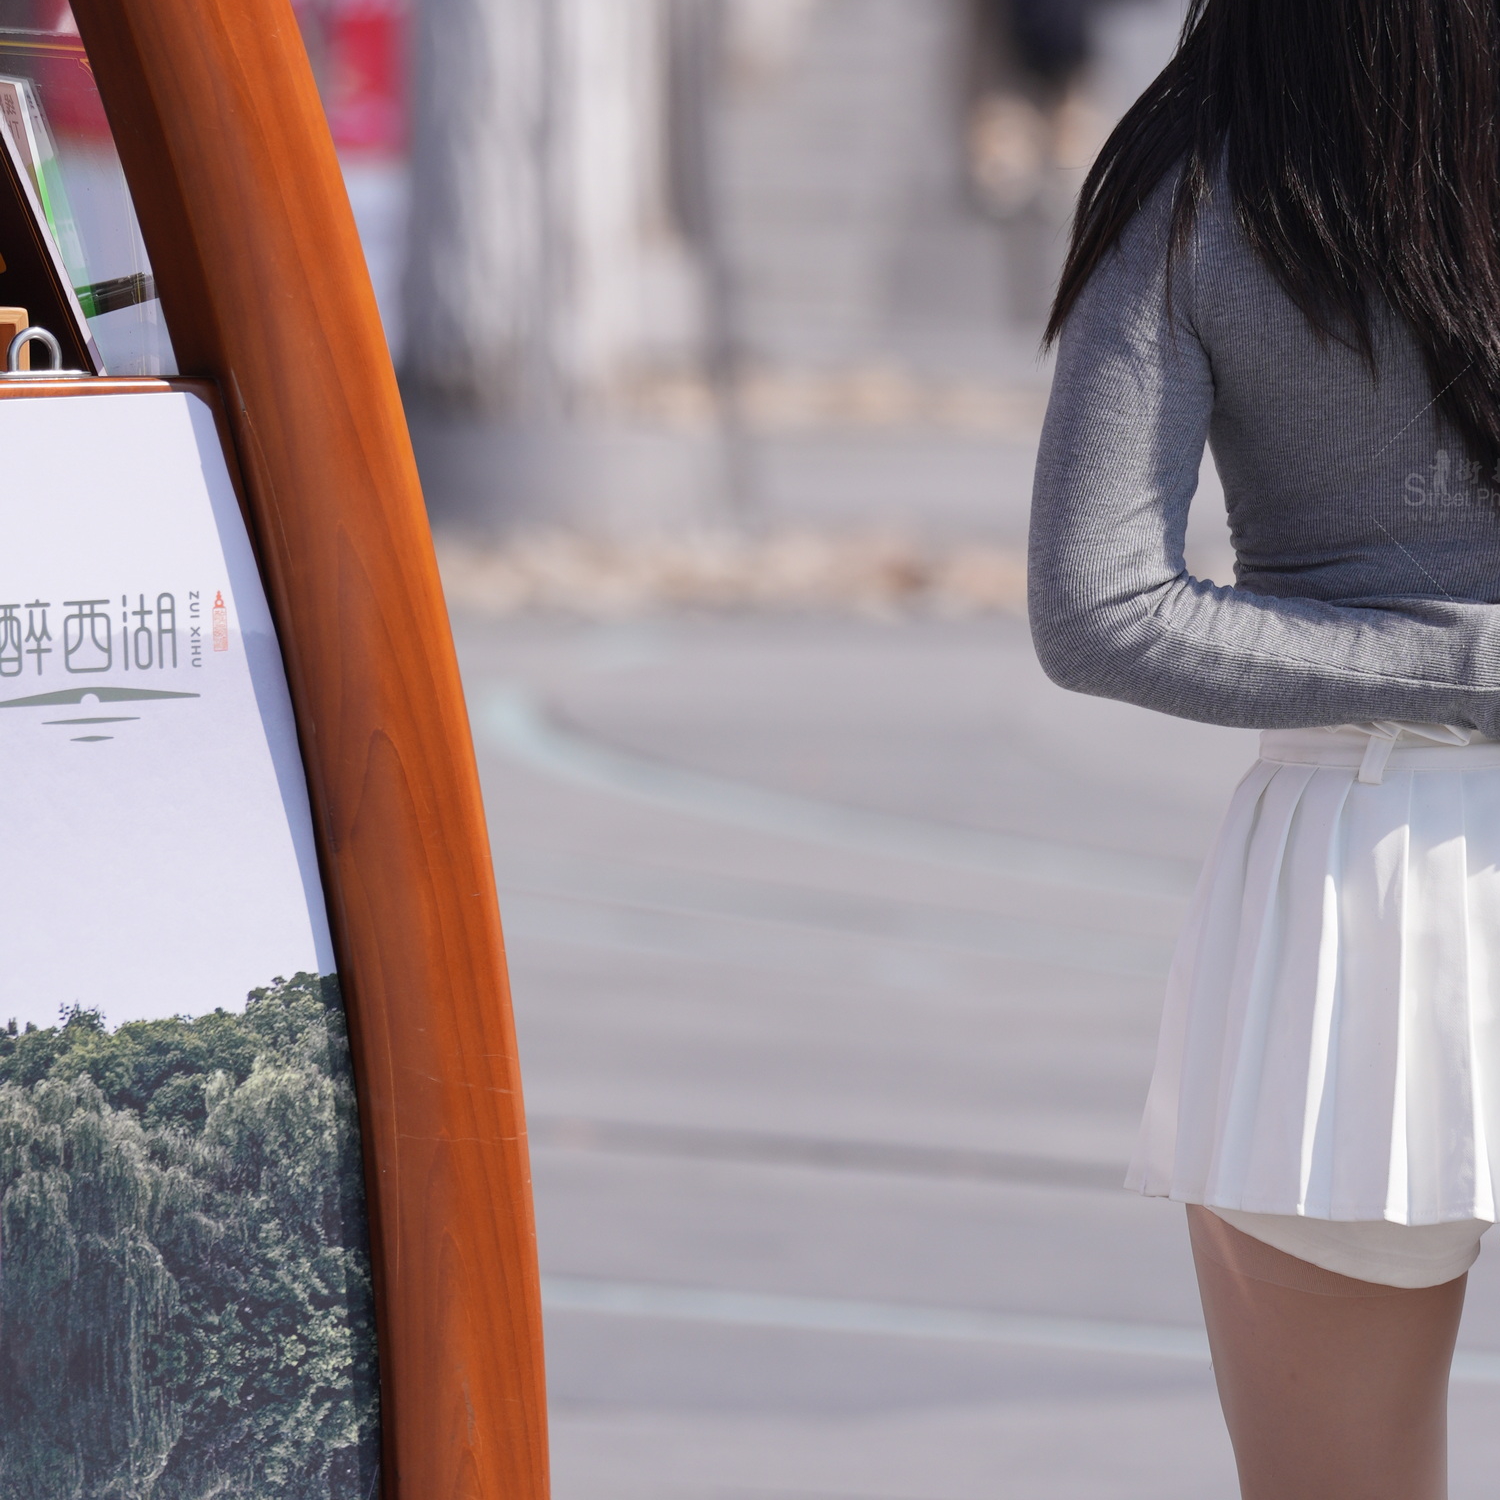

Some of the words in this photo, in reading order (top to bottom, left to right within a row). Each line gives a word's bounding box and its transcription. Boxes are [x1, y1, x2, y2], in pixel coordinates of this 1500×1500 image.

[189, 591, 200, 618] ZUI
[0, 592, 178, 677] 醉西湖
[190, 626, 202, 668] XIHU
